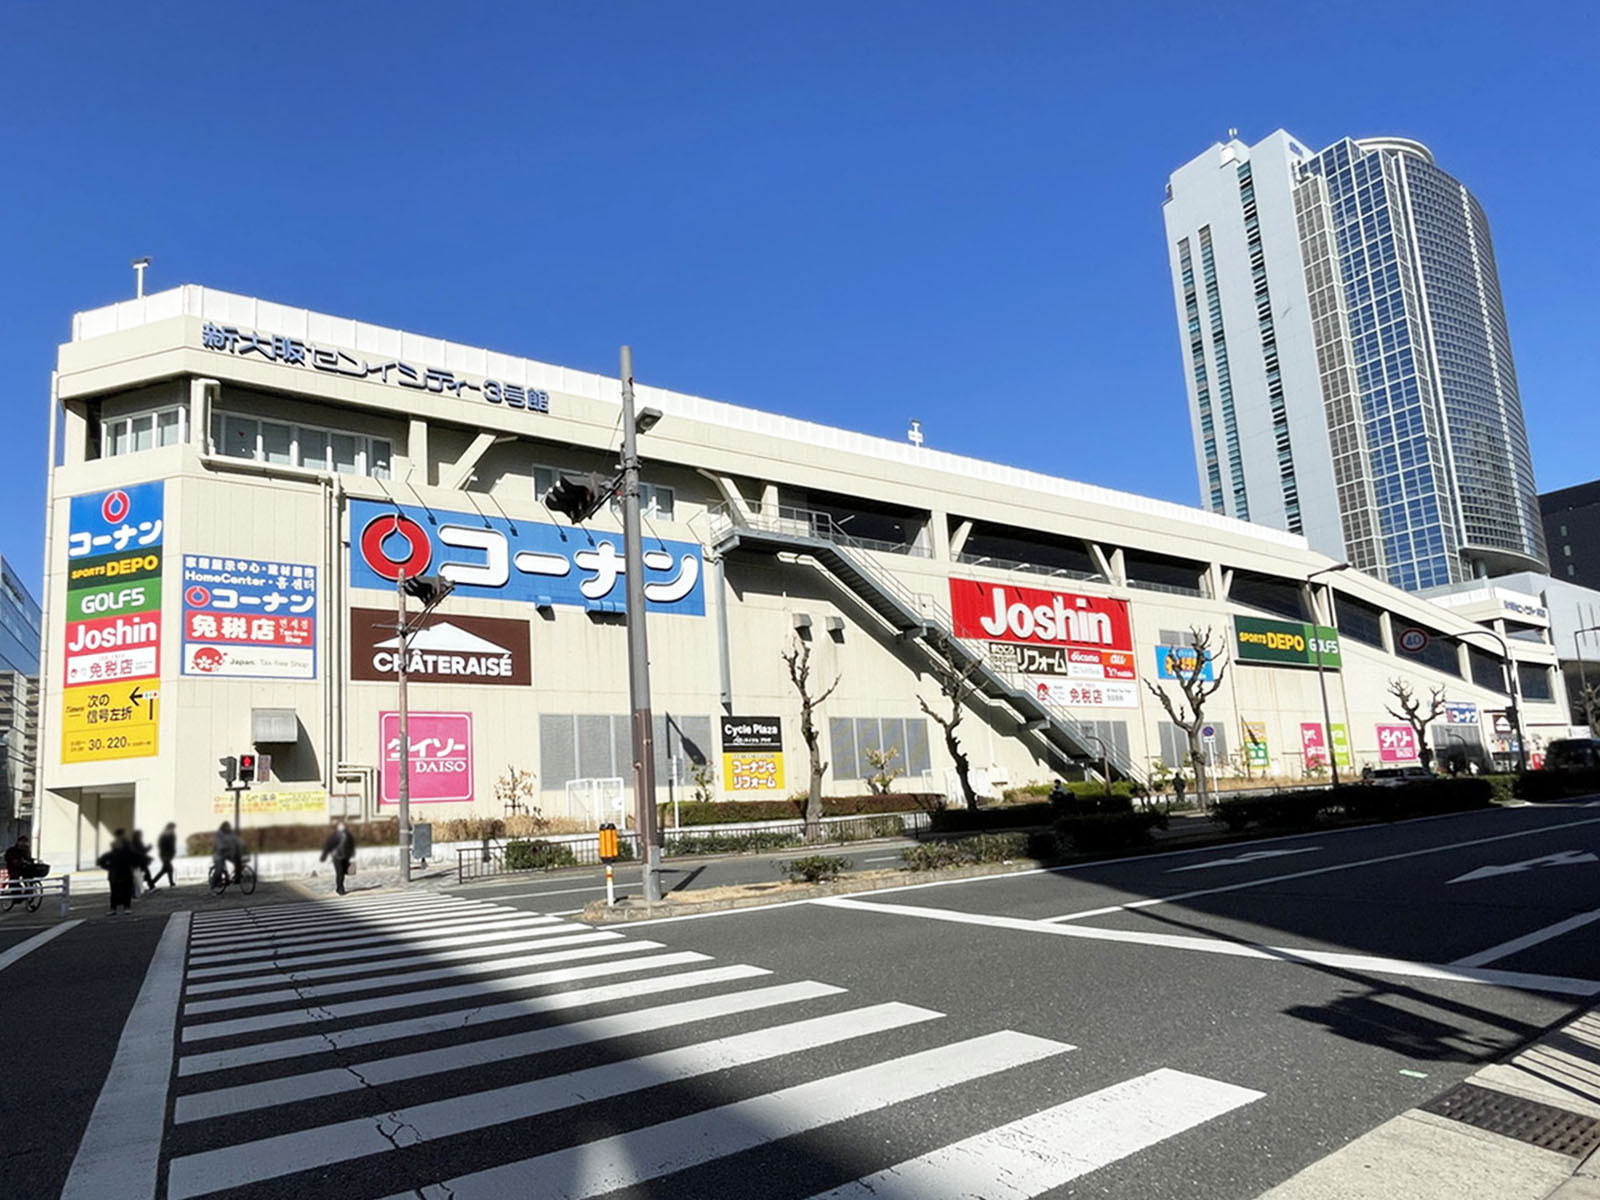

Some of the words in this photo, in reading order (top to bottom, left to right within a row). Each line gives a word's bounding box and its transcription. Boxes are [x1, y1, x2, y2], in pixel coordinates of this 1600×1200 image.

[69, 519, 163, 557] コーナン
[71, 566, 106, 579] SPORTS
[106, 555, 159, 577] DEPO
[437, 524, 699, 602] コーナン
[185, 570, 266, 586] HomeCenter
[81, 587, 146, 614] GOLF5
[211, 588, 315, 613] コーナン
[980, 587, 1113, 645] Joshin
[68, 617, 157, 652] Joshin
[191, 614, 276, 641] 免税店
[1239, 631, 1267, 645] SPORTS
[1267, 631, 1306, 652] DEPO
[372, 648, 513, 678] CHÂTERAISÉ
[1016, 647, 1068, 673] リフォーム
[1071, 651, 1100, 663] docomo
[89, 658, 133, 679] 免税店
[87, 693, 111, 708] 次の
[1069, 687, 1103, 704] 免税店
[86, 705, 133, 725] 信号左折
[725, 724, 751, 736] Cycle
[752, 724, 778, 735] Plaza
[415, 761, 467, 773] DAISO
[733, 776, 777, 789] リフォーム
